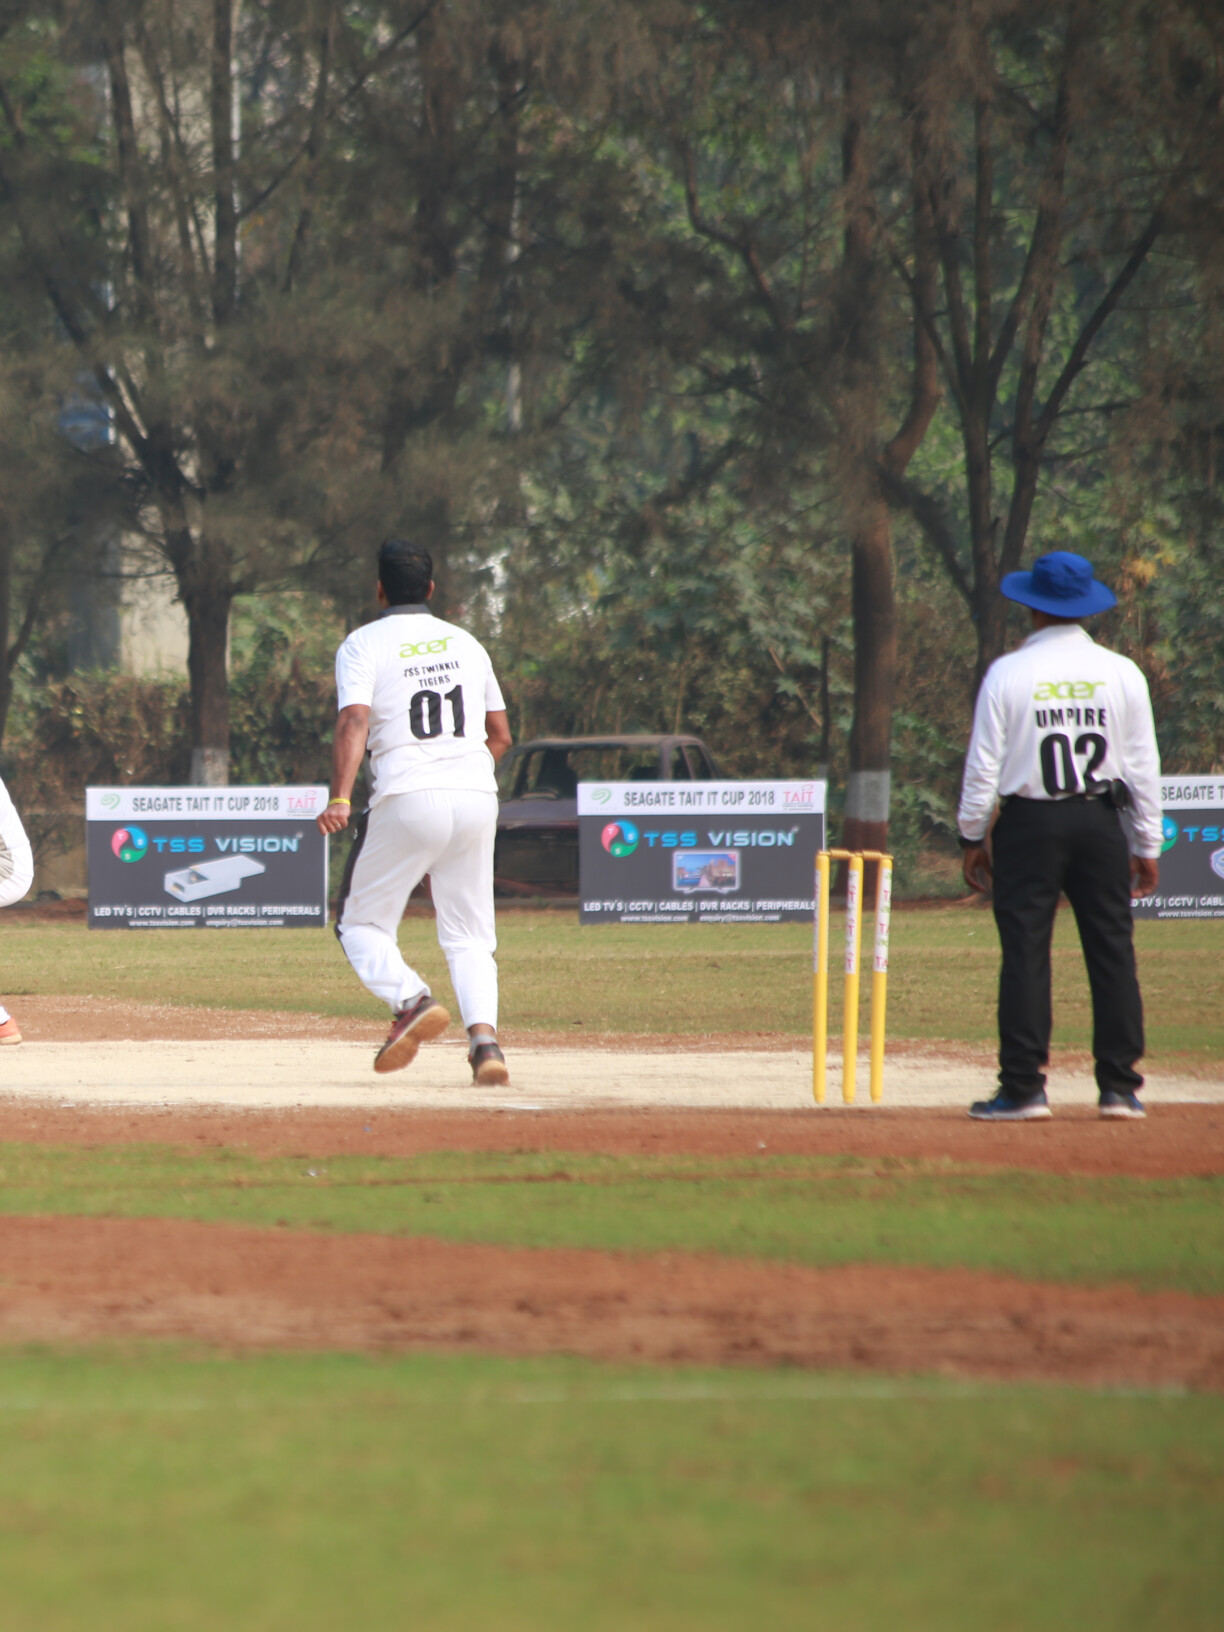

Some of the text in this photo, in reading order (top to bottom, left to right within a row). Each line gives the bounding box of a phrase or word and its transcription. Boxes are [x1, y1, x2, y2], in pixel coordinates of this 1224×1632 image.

[400, 636, 453, 658] acer
[421, 661, 460, 674] TWINKLE
[418, 675, 450, 688] TIGERS
[1034, 681, 1107, 701] acer
[409, 684, 465, 740] 01
[1036, 708, 1107, 728] UMPIRE
[1041, 733, 1112, 797] 02
[624, 791, 774, 806] SEAGATE TAIT IT CUP 2018
[1162, 786, 1214, 800] SEAGATE
[132, 797, 279, 812] SEAGATE TAIT IT CUP 2018
[152, 838, 299, 852] TSS VISION
[643, 831, 794, 847] TSS VISION
[584, 903, 601, 911] LED
[629, 902, 653, 911] CCTV
[659, 902, 693, 911] CABLES
[700, 902, 718, 910] DVR
[720, 901, 750, 910] RACKS
[756, 901, 816, 910] PERIPHERALS
[1168, 897, 1193, 907] CCTV
[1200, 896, 1224, 906] CABL
[94, 907, 111, 916] LED
[138, 907, 162, 916] CCTV
[168, 907, 201, 916] CABLES
[227, 907, 256, 915] RACKS
[262, 906, 320, 915] PERIPHERALS
